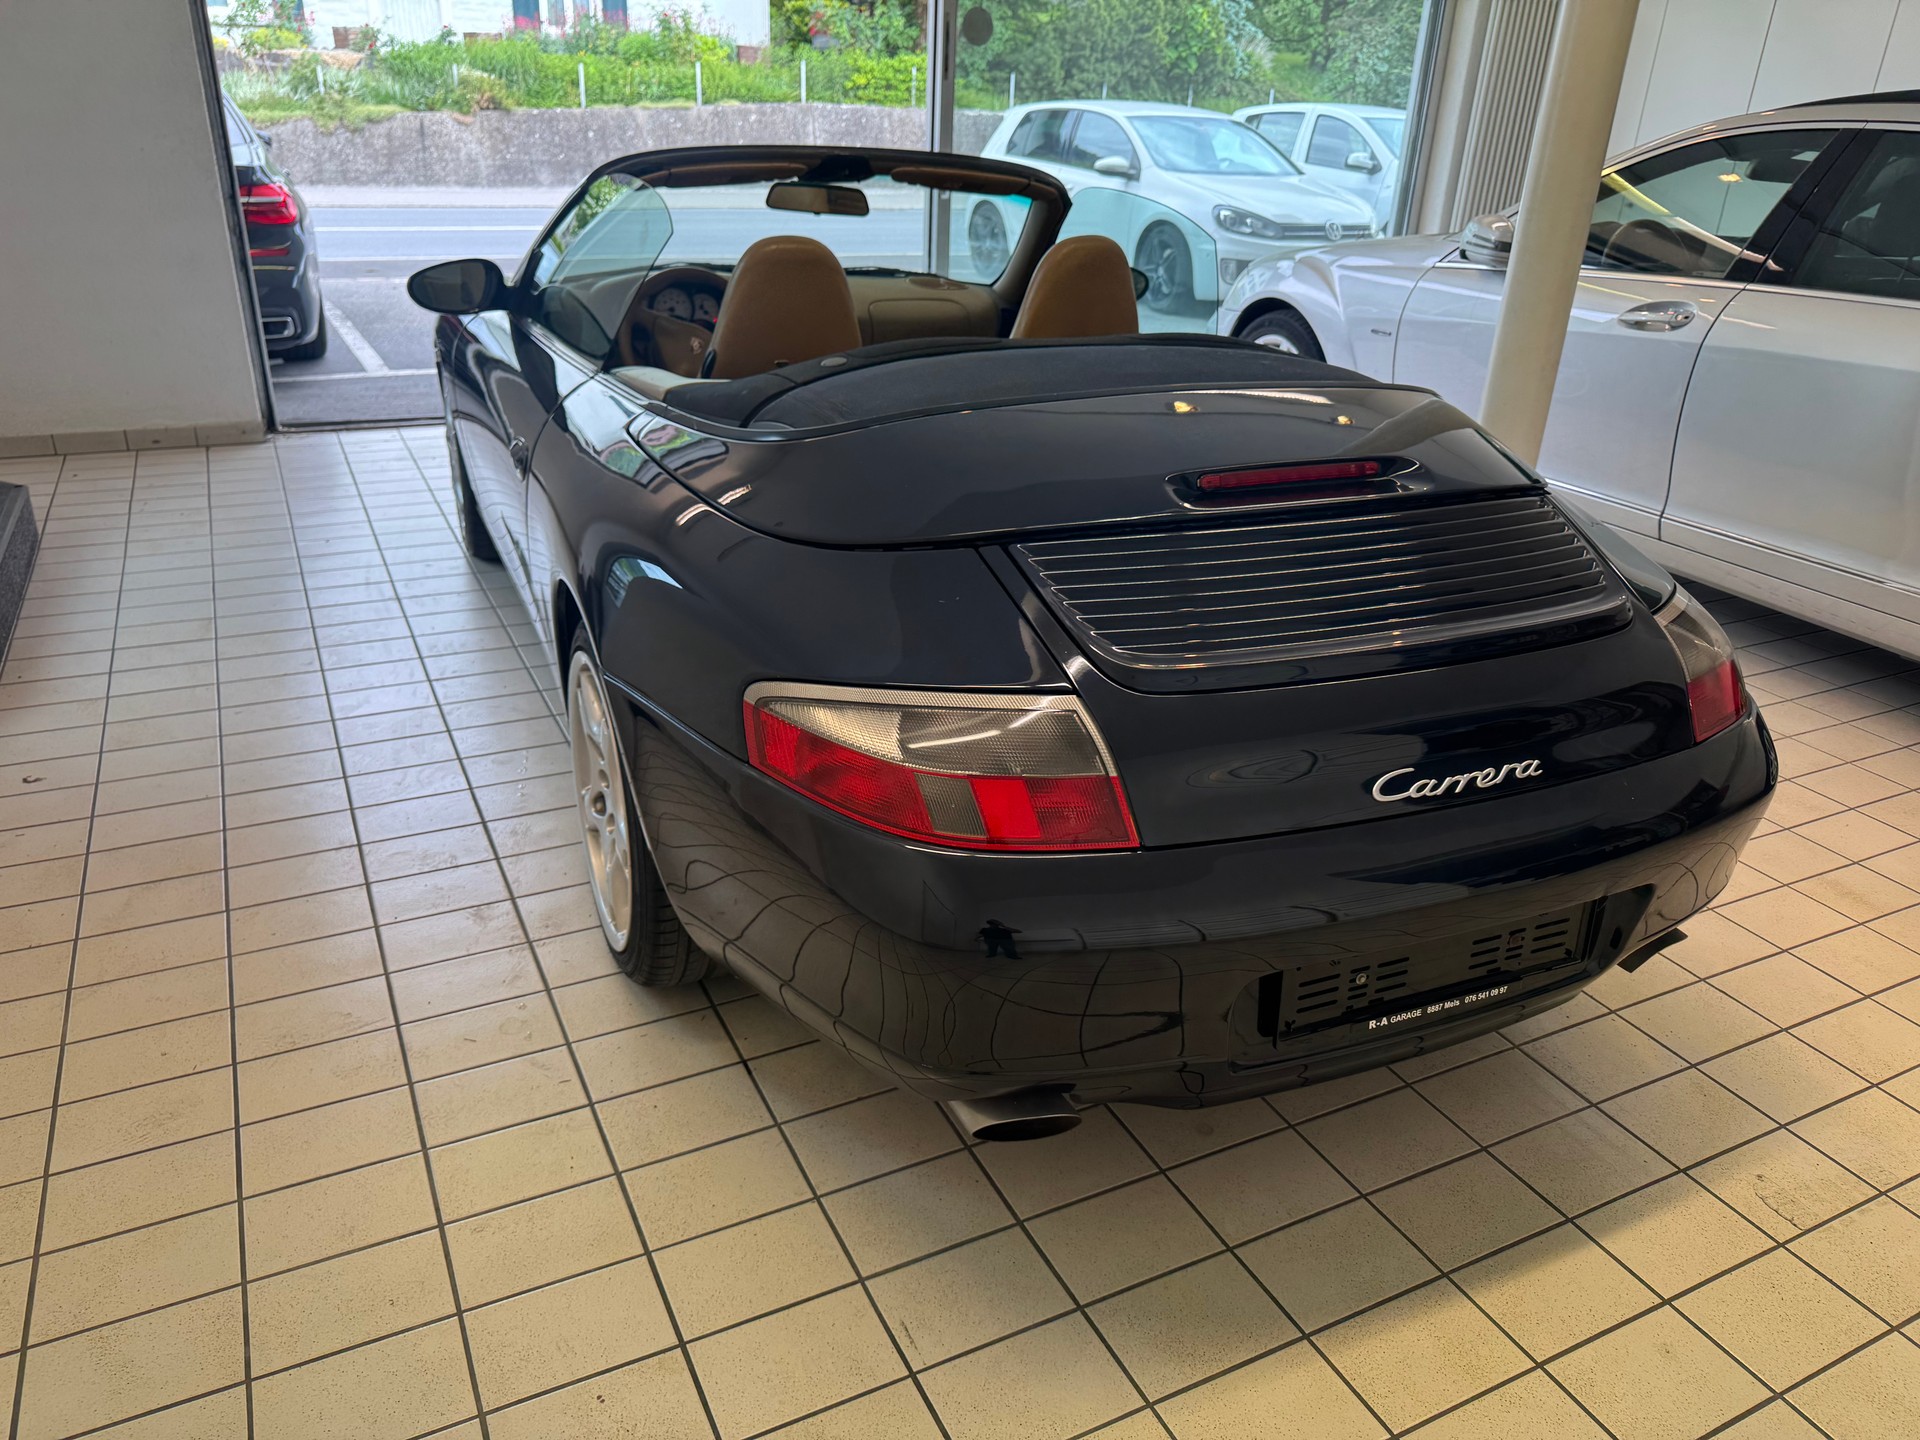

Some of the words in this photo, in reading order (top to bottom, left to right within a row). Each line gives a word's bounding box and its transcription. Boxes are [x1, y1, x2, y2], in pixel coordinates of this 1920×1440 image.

[1372, 759, 1543, 802] Carrera
[1368, 1017, 1389, 1030] R-A
[1390, 1008, 1422, 1024] GARAGE
[1426, 1003, 1443, 1014] 8887
[1443, 999, 1460, 1009] Mels
[1464, 994, 1477, 1004] 076
[1477, 990, 1489, 1000] 541
[1490, 988, 1499, 997] 09
[1499, 985, 1508, 994] 97
